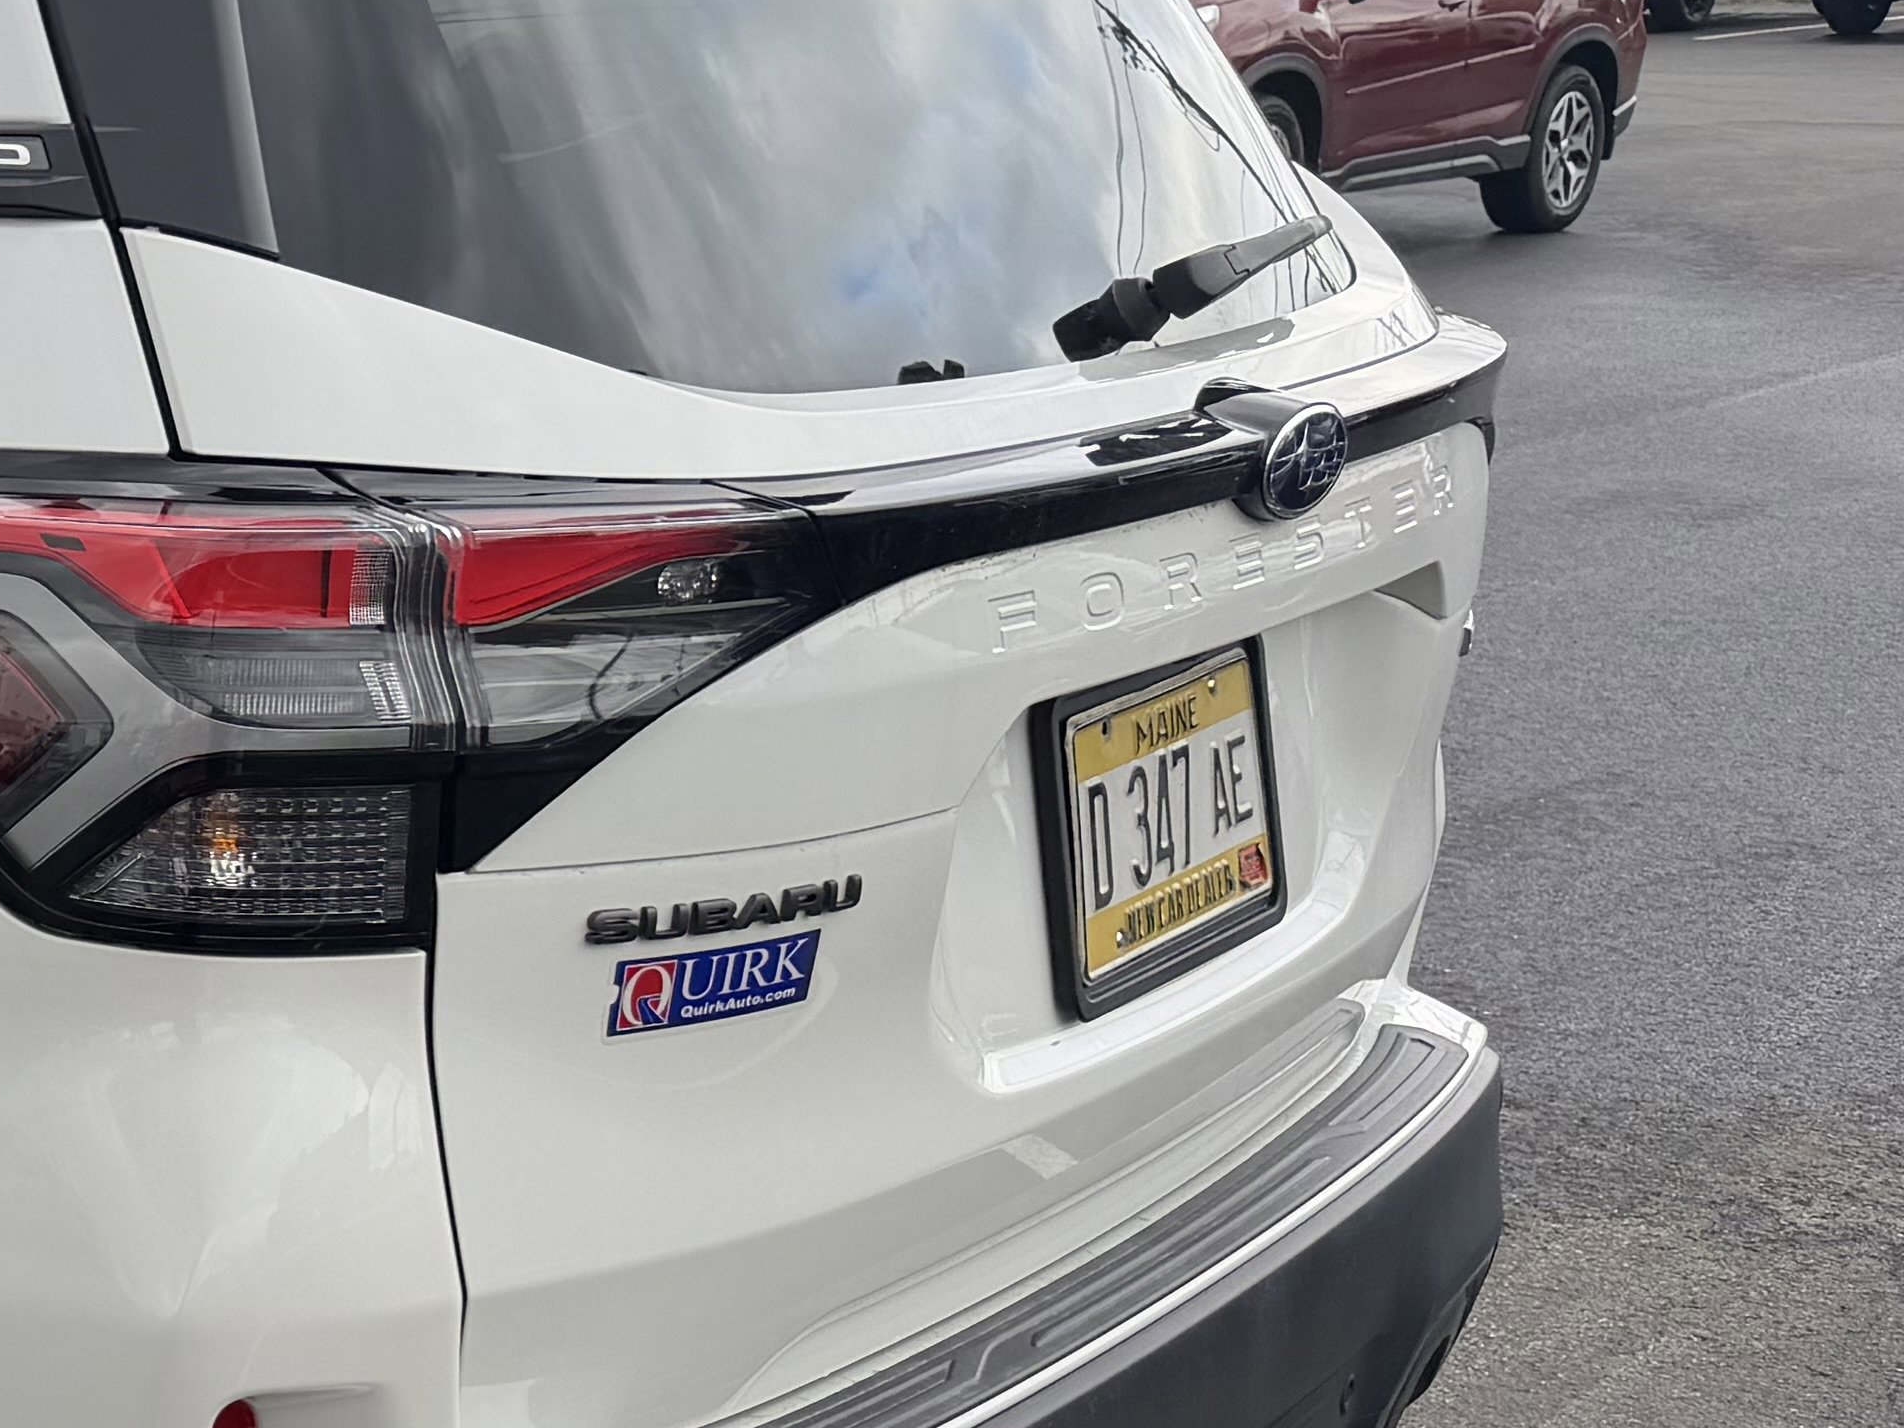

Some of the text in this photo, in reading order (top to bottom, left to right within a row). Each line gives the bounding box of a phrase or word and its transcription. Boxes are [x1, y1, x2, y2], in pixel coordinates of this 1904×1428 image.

[987, 464, 1456, 655] FORESTER
[1135, 693, 1199, 754] MAINE
[1087, 732, 1254, 911] D 347 AE
[584, 873, 863, 945] SUBARU
[1123, 897, 1156, 943] NEW
[1156, 882, 1184, 928] CAR
[1185, 859, 1235, 915] DEALER
[620, 936, 810, 1026] QUIRK
[679, 986, 797, 1019] QuirkAuto.com
